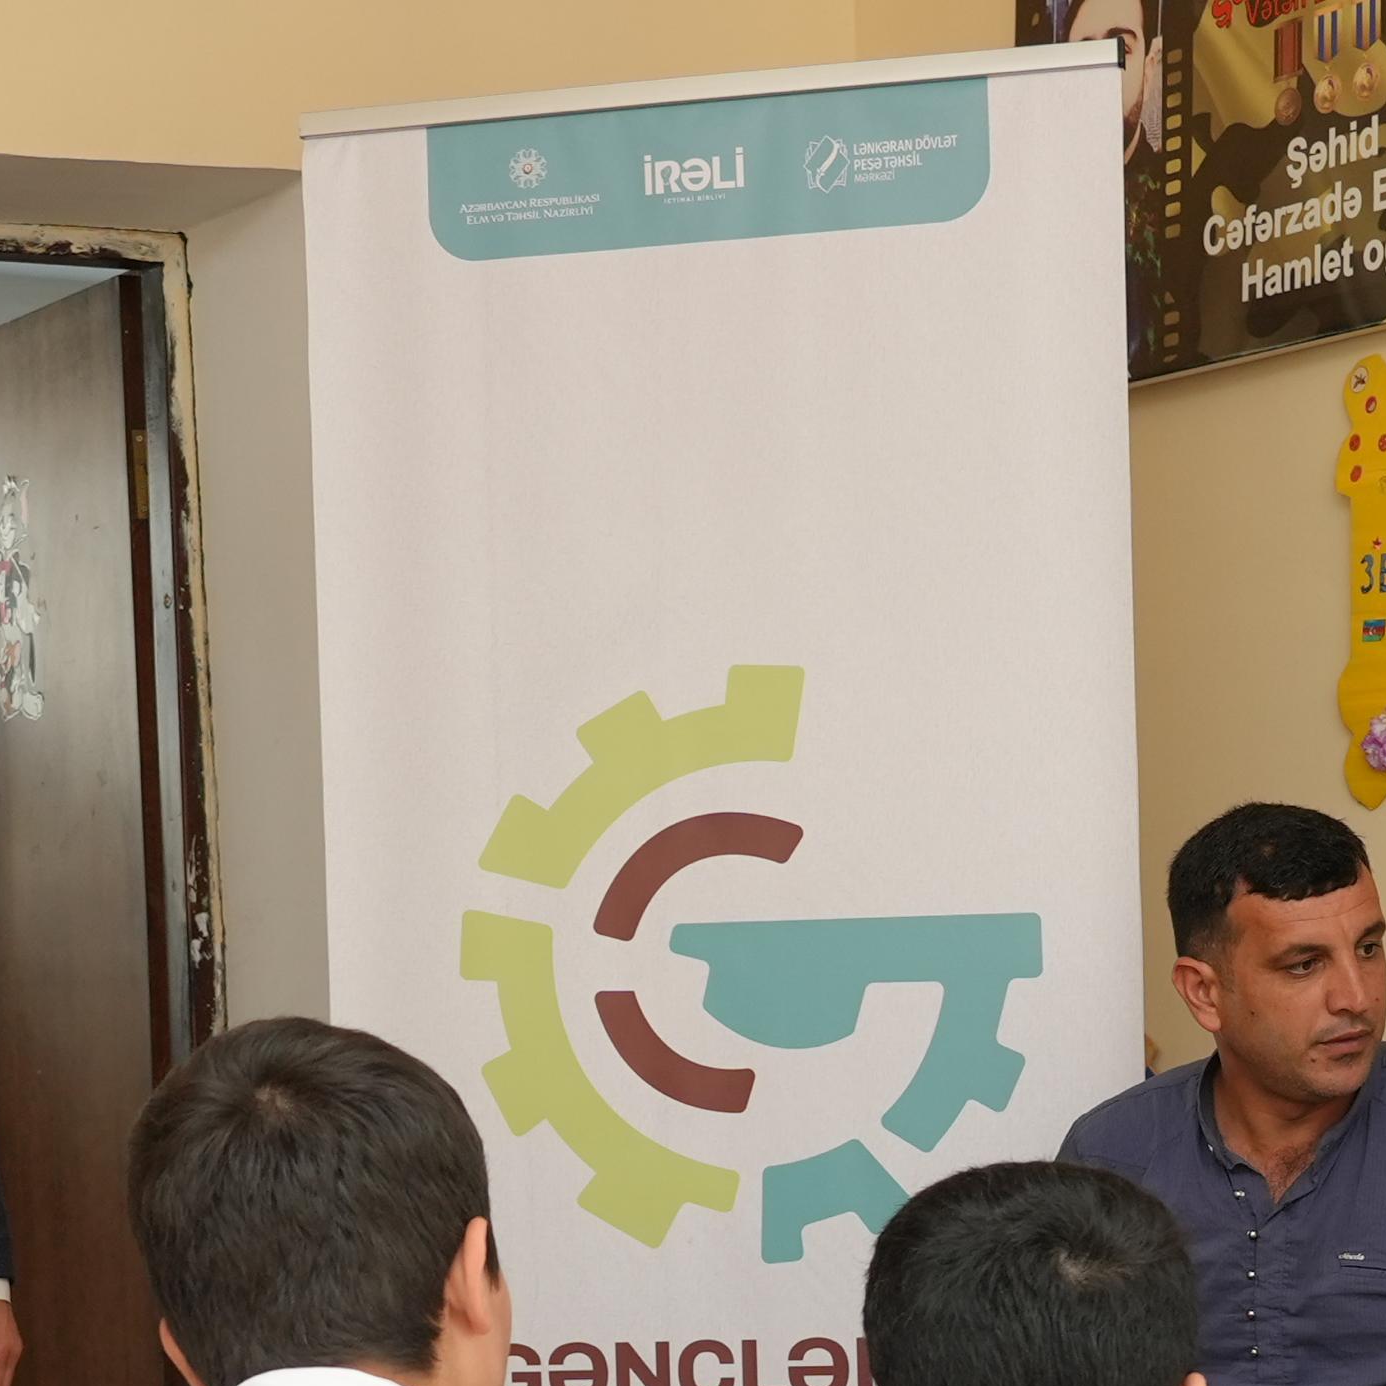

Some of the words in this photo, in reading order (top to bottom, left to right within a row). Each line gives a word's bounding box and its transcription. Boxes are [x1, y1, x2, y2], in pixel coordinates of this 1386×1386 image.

[643, 146, 745, 196] İRƏLİ
[853, 139, 913, 156] LƏNKƏRAN
[915, 134, 958, 150] DÖVLƏT
[884, 151, 923, 168] TƏHSİL
[1286, 114, 1379, 189] Şəhid
[1202, 180, 1363, 256] Cəfərzadə
[1241, 235, 1354, 303] Hamlet
